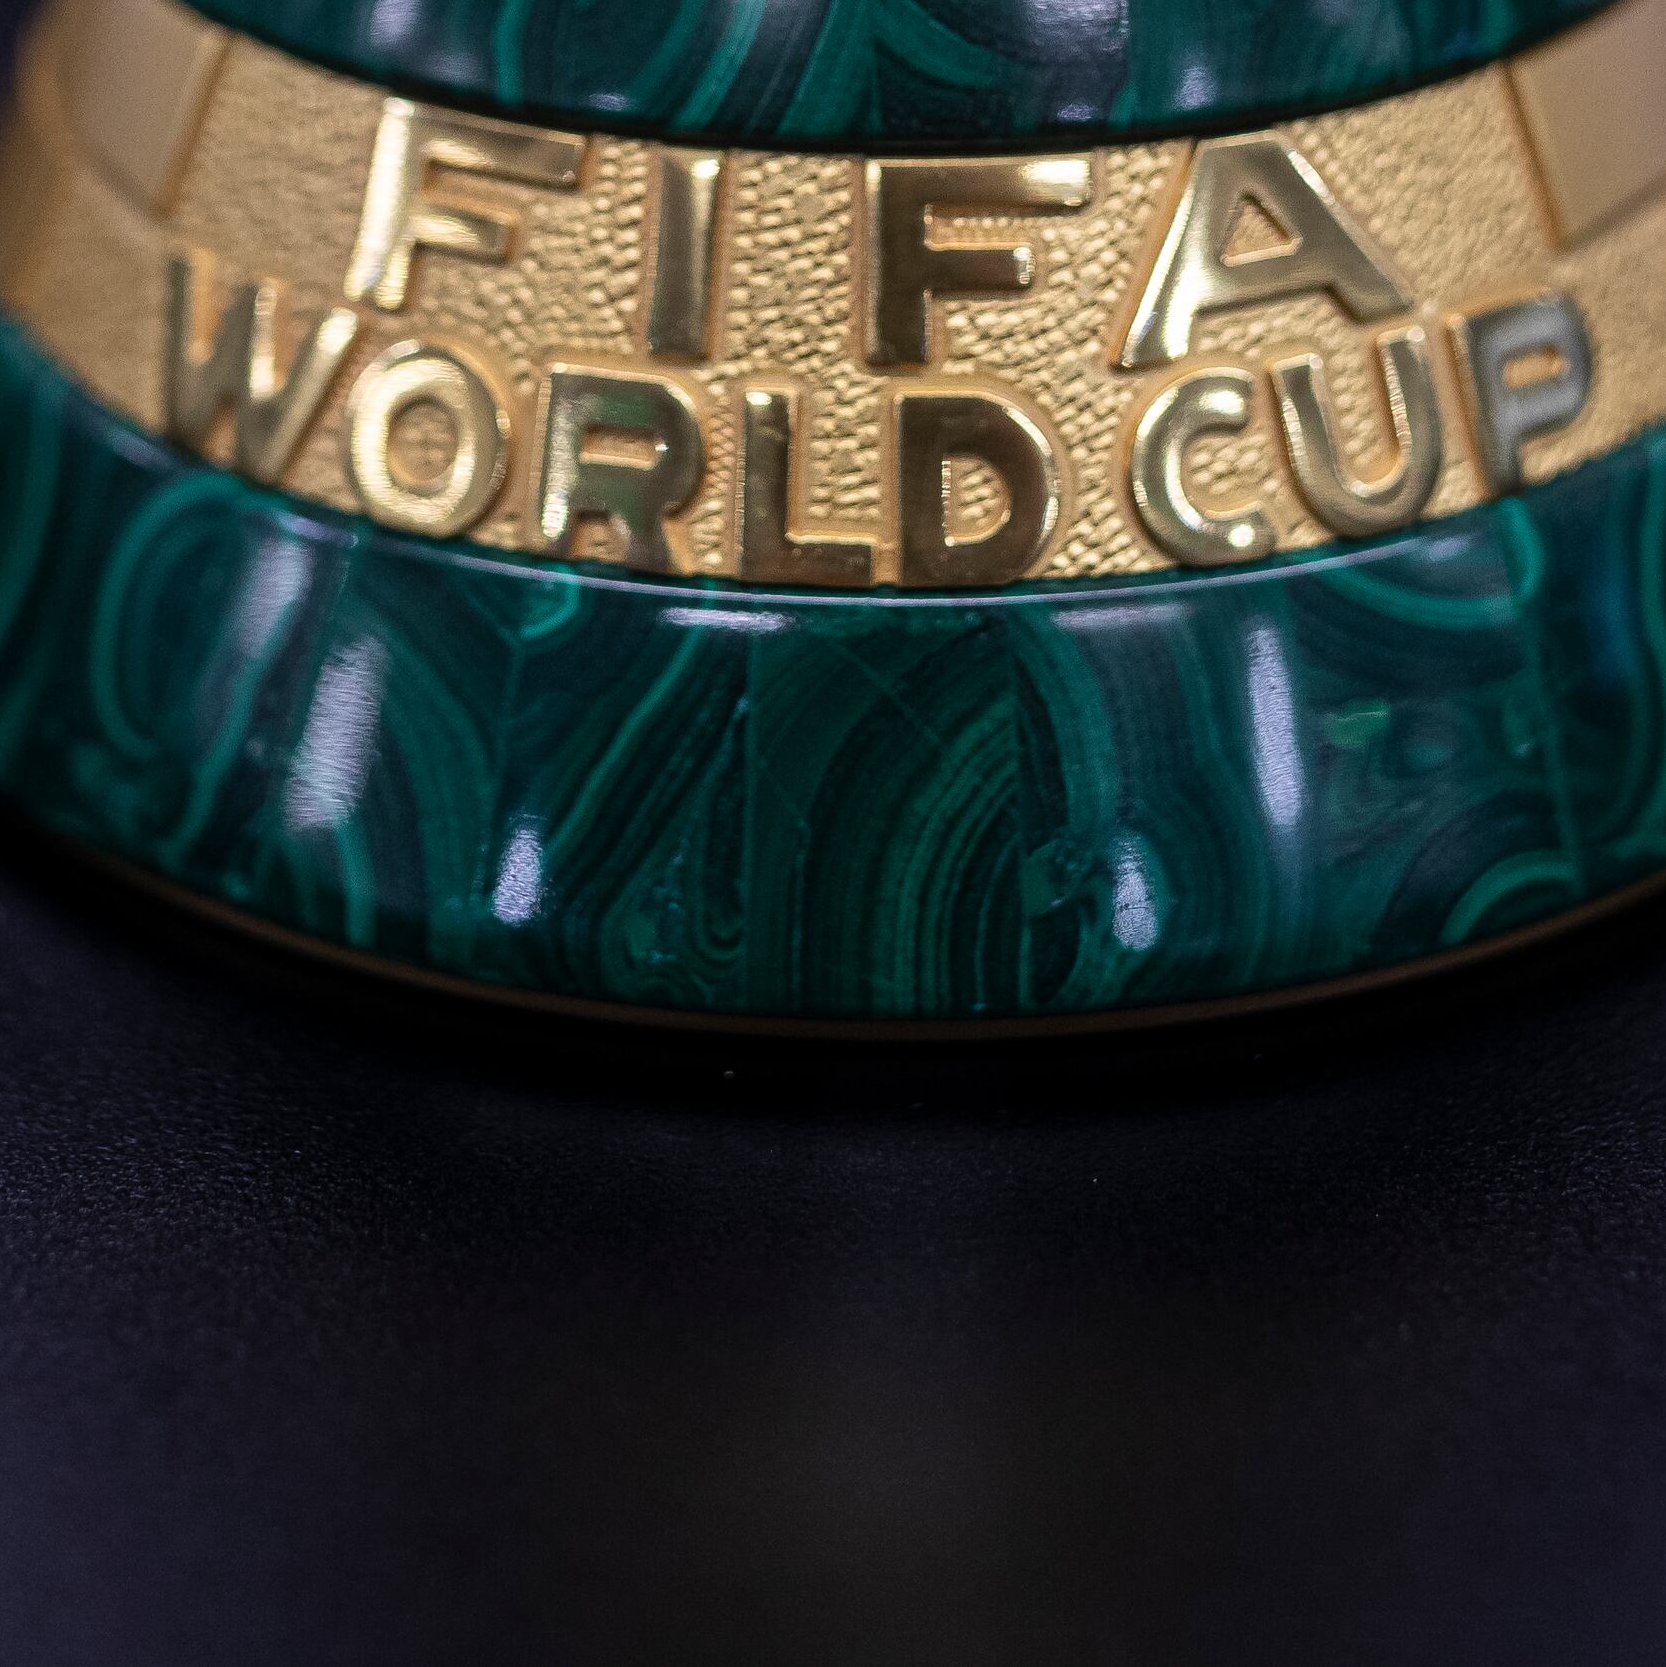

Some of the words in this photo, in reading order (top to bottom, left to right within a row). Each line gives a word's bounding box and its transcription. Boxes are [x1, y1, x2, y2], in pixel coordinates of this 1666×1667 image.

[347, 97, 1411, 368] FIFA
[167, 252, 1061, 584] WORLD
[1132, 291, 1593, 564] CUP
